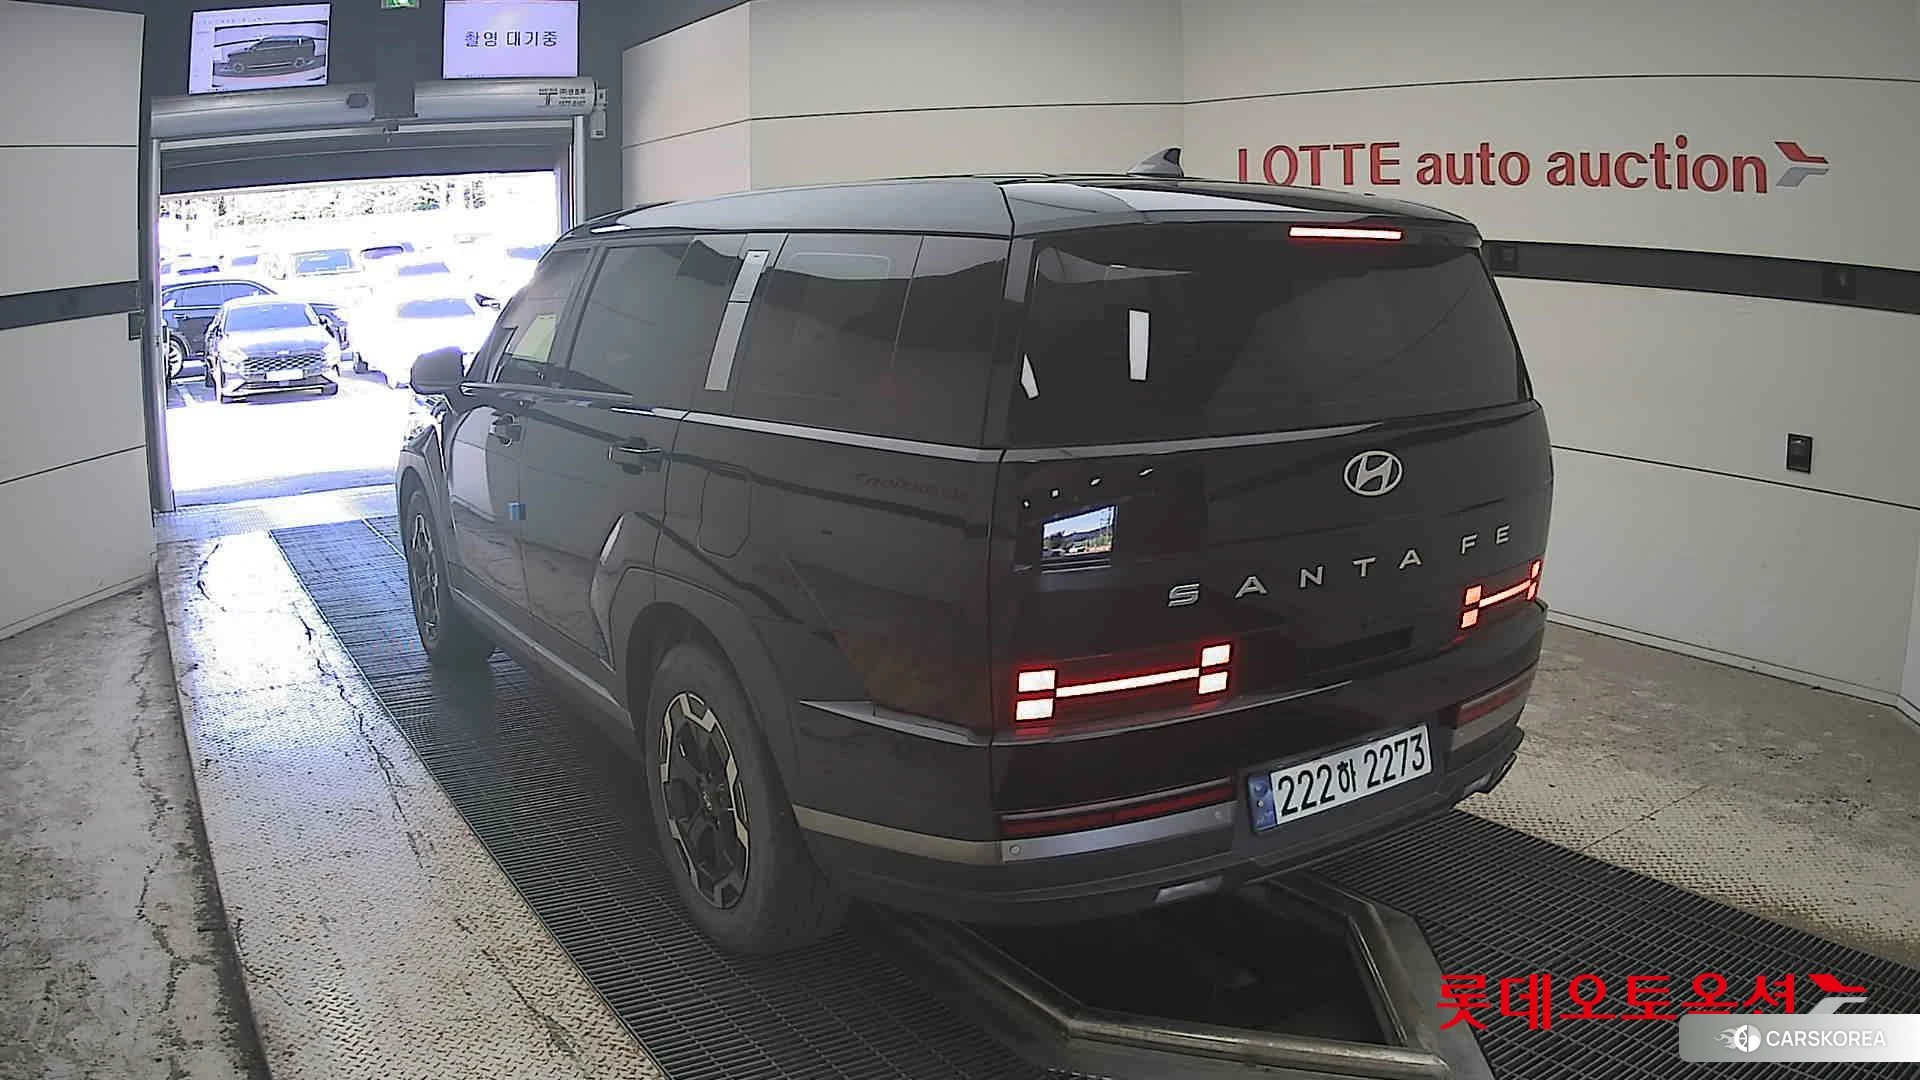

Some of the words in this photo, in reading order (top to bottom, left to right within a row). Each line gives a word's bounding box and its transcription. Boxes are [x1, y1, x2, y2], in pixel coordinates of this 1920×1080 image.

[506, 31, 557, 47] 대기중
[1238, 142, 1400, 186] LOTTE
[1416, 142, 1530, 186] auto
[1546, 135, 1767, 193] auction
[1167, 549, 1422, 607] SANTA
[1461, 525, 1510, 553] FE
[1278, 758, 1357, 817] 222하
[1363, 733, 1425, 789] 2273
